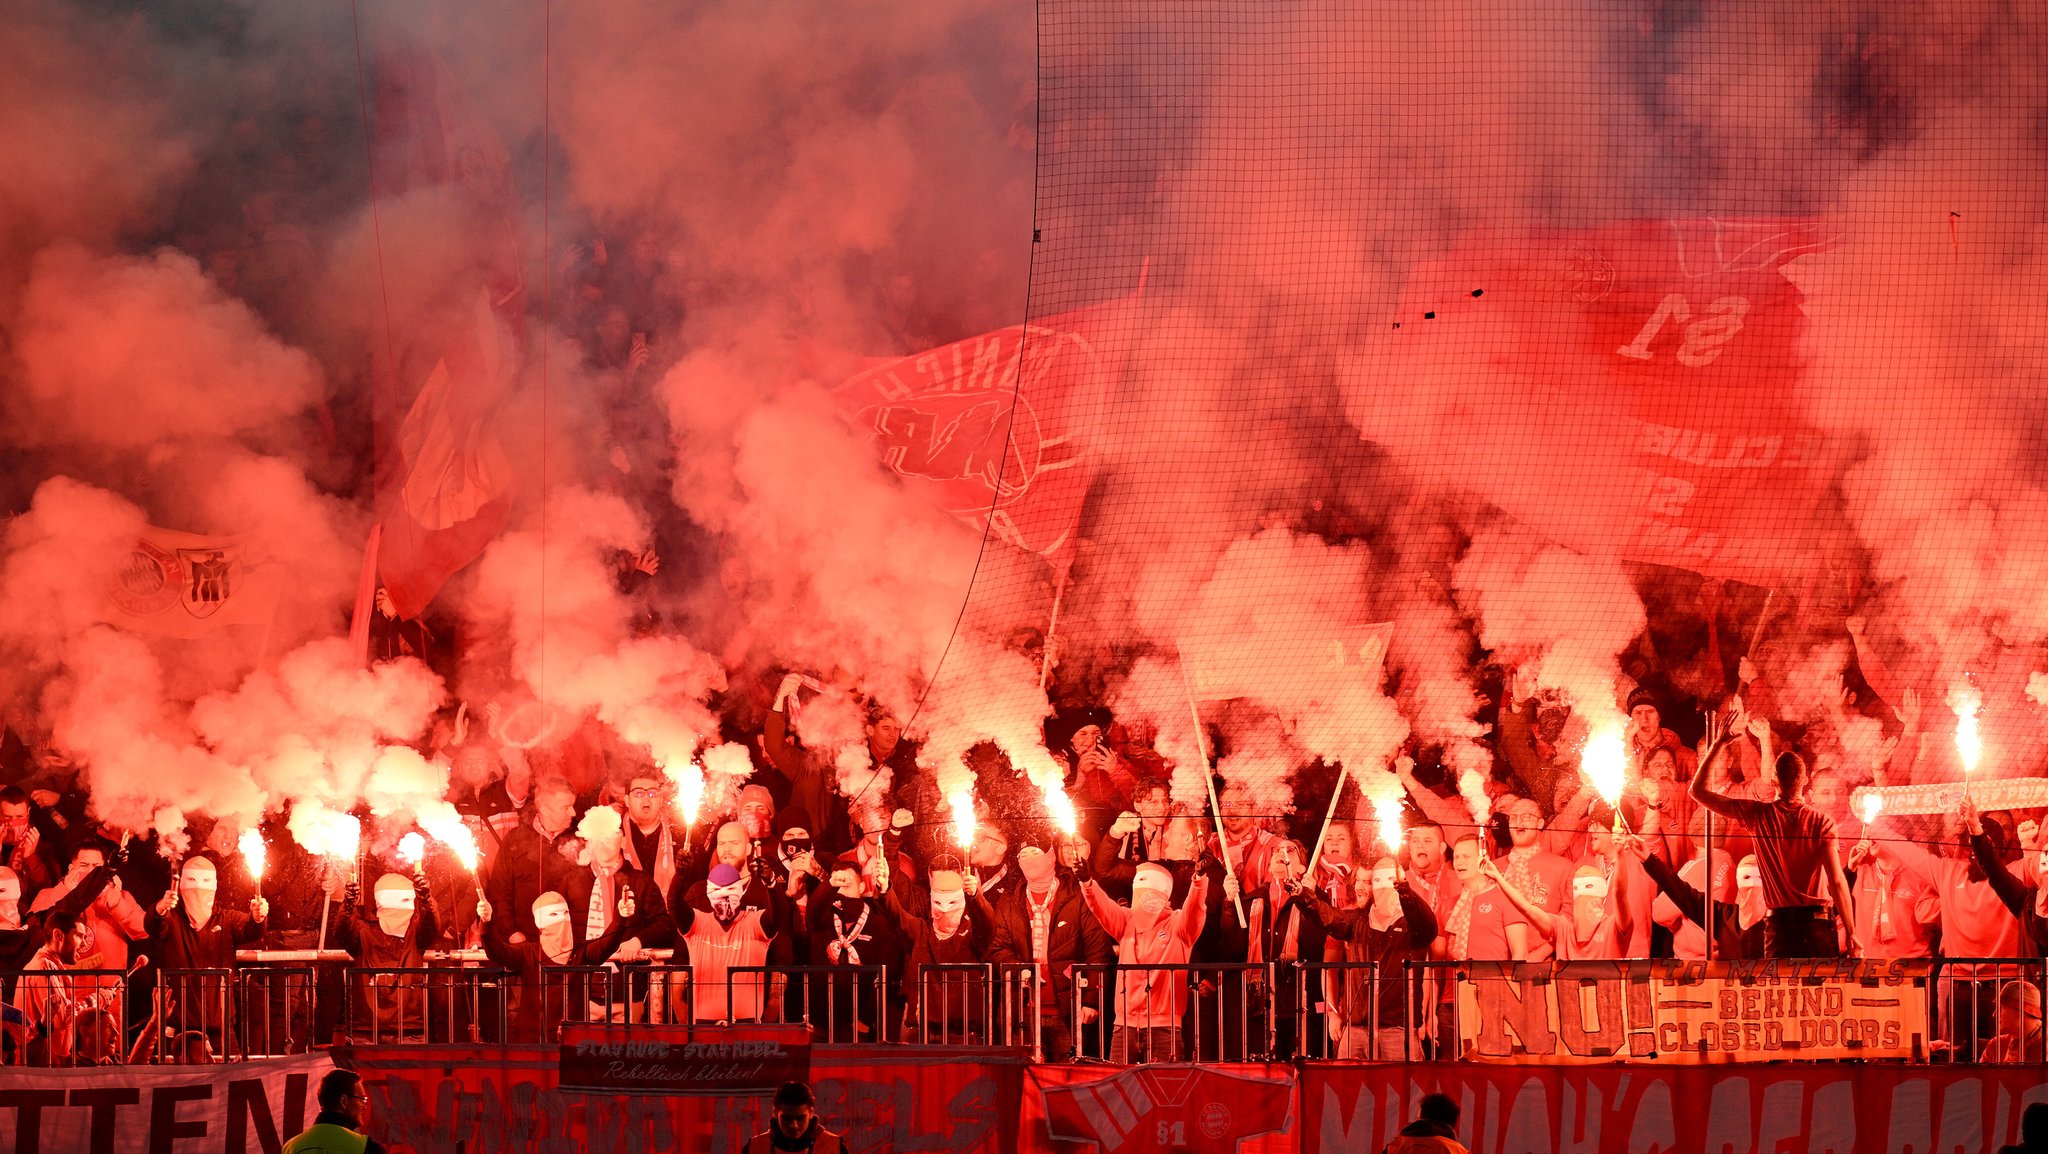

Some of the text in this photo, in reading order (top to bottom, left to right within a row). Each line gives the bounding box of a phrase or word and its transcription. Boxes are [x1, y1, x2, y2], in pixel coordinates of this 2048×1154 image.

[1660, 959, 1910, 987] TO MATCHES
[1469, 960, 1656, 1057] NO!
[1719, 988, 1844, 1020] BEHIND
[1659, 1019, 1900, 1052] CLOSED DOORS
[602, 1060, 764, 1083] Rebellisch bleiben!
[1156, 1119, 1186, 1146] §1
